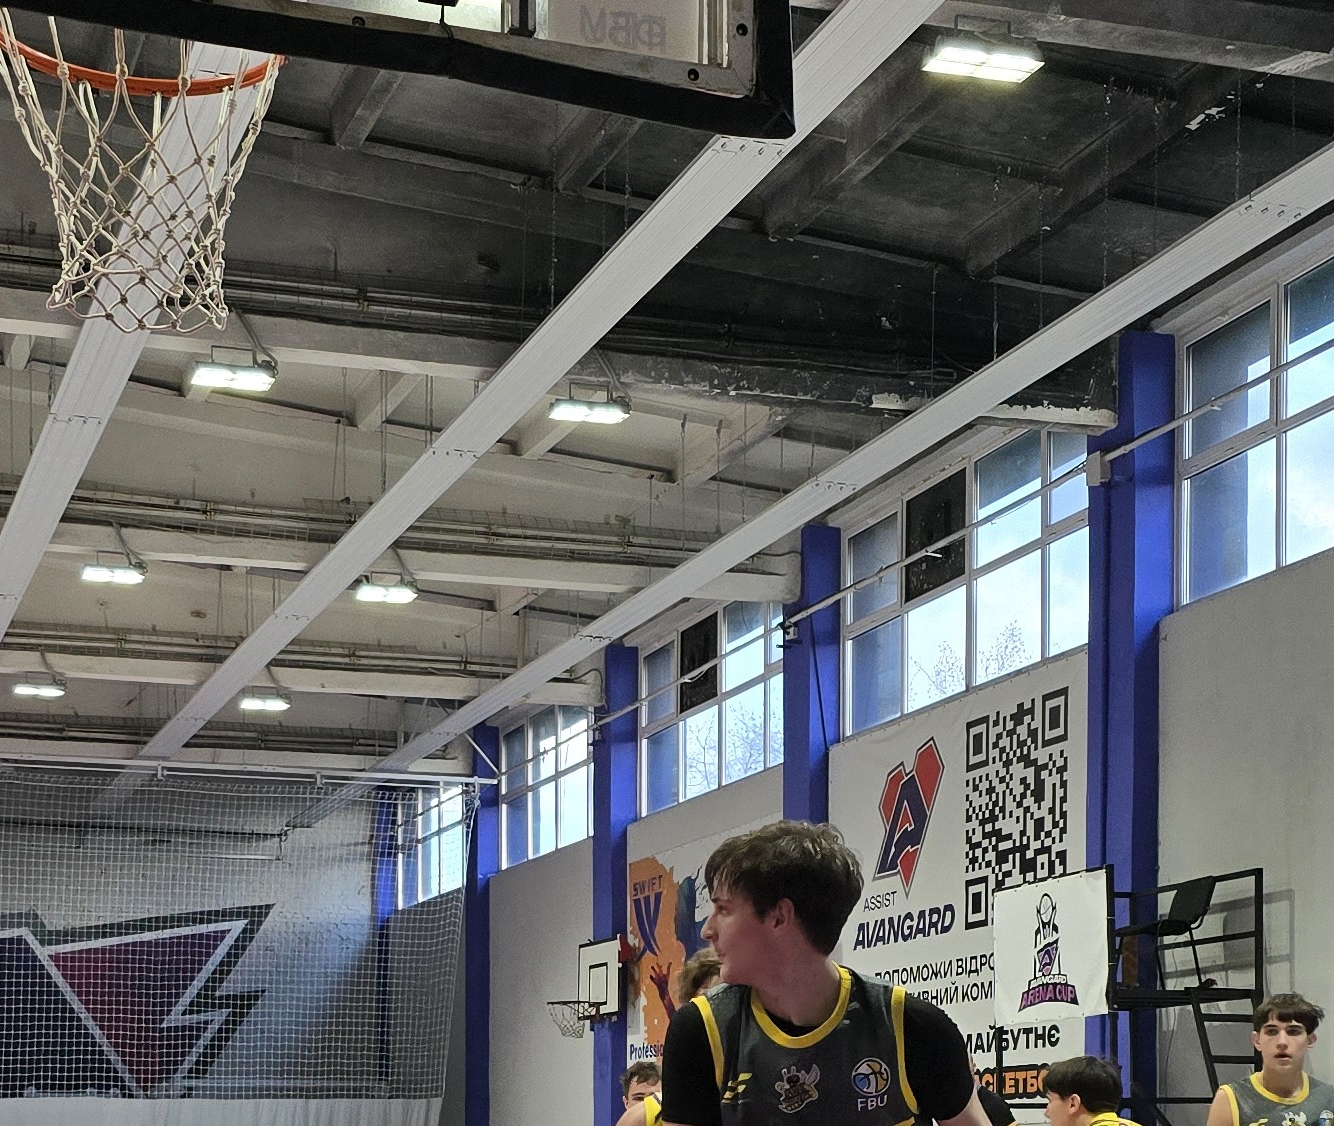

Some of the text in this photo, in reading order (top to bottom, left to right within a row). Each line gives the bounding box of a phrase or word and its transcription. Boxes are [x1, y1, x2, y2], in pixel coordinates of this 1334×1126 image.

[633, 875, 664, 898] SWIFT
[863, 891, 898, 912] ASSIST
[854, 904, 956, 950] AVANGARD
[1021, 985, 1075, 1009] ARENA CUP
[857, 1095, 888, 1112] FBU
